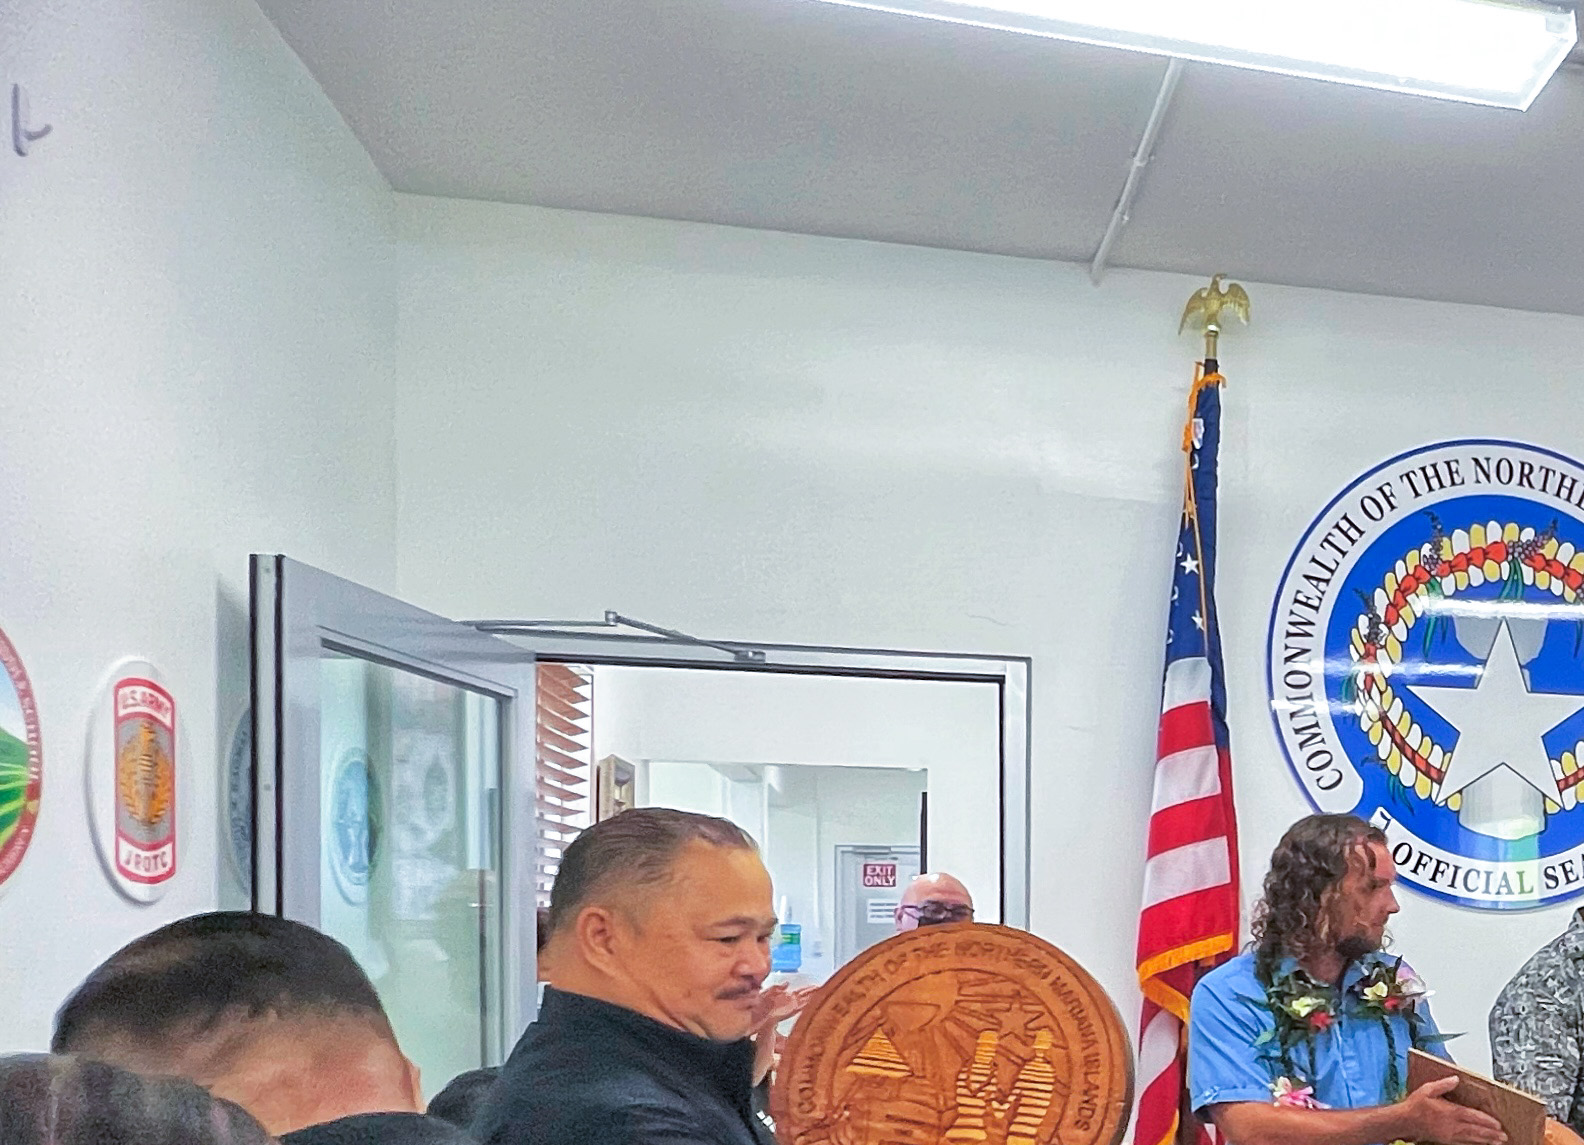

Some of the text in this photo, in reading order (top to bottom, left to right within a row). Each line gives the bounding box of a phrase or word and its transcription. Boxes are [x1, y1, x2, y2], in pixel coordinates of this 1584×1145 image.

[1283, 515, 1365, 791] COMMONWEALTH
[1359, 487, 1398, 524] OF
[1400, 459, 1466, 500] THE
[864, 875, 896, 886] ONLY
[866, 865, 894, 875] EXIT
[1392, 841, 1534, 896] OFFICIAL
